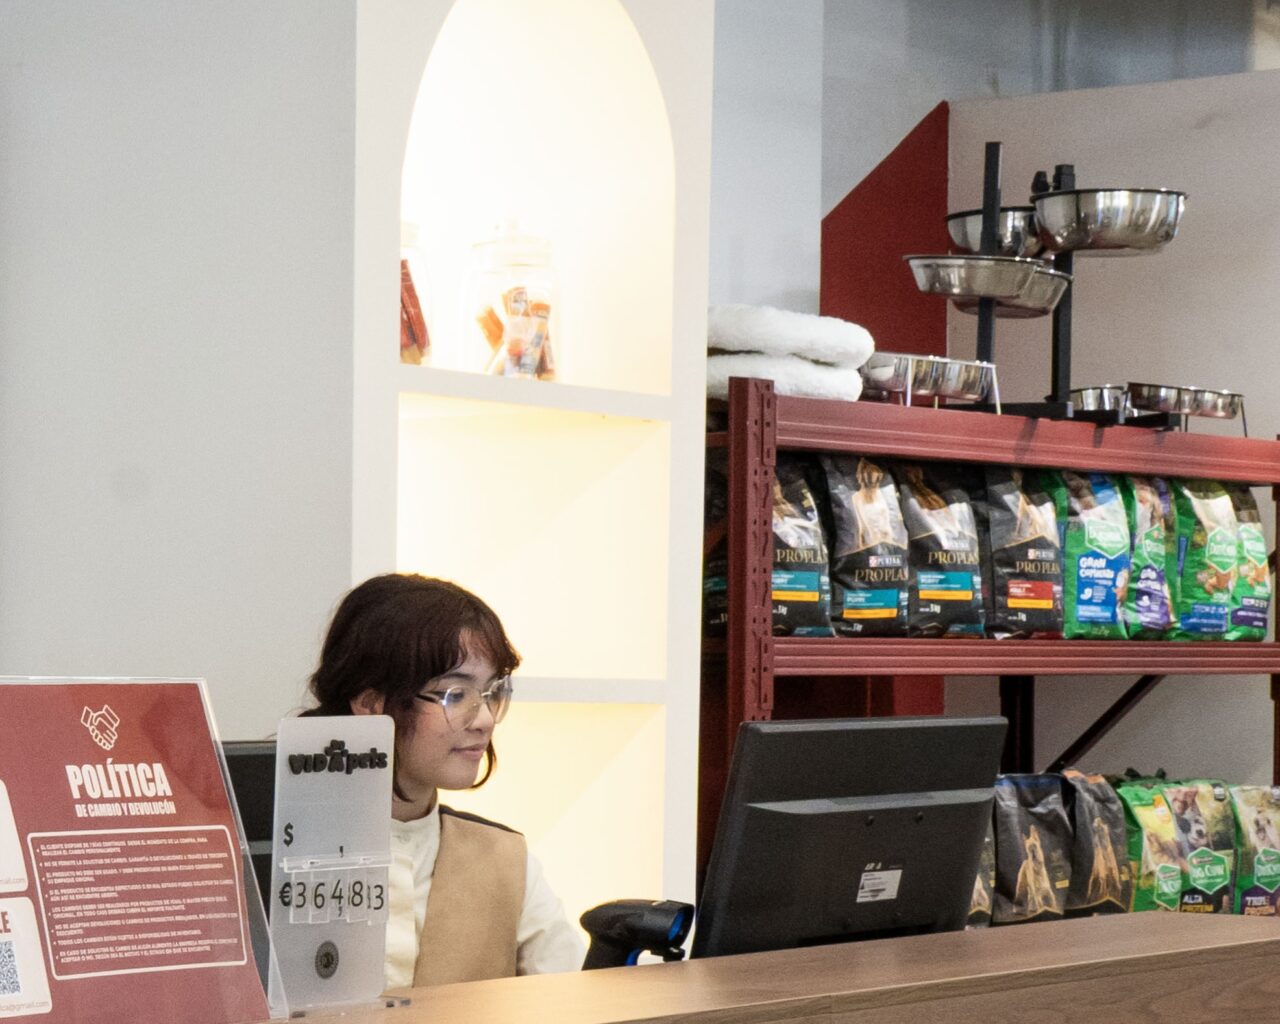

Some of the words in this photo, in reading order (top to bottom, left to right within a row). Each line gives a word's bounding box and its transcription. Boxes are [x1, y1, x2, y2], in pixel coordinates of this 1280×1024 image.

[65, 758, 173, 799] POLÍTICA
[75, 804, 88, 817] DE
[87, 803, 121, 817] CAMBIO
[121, 803, 130, 816] Y
[283, 823, 294, 847] $
